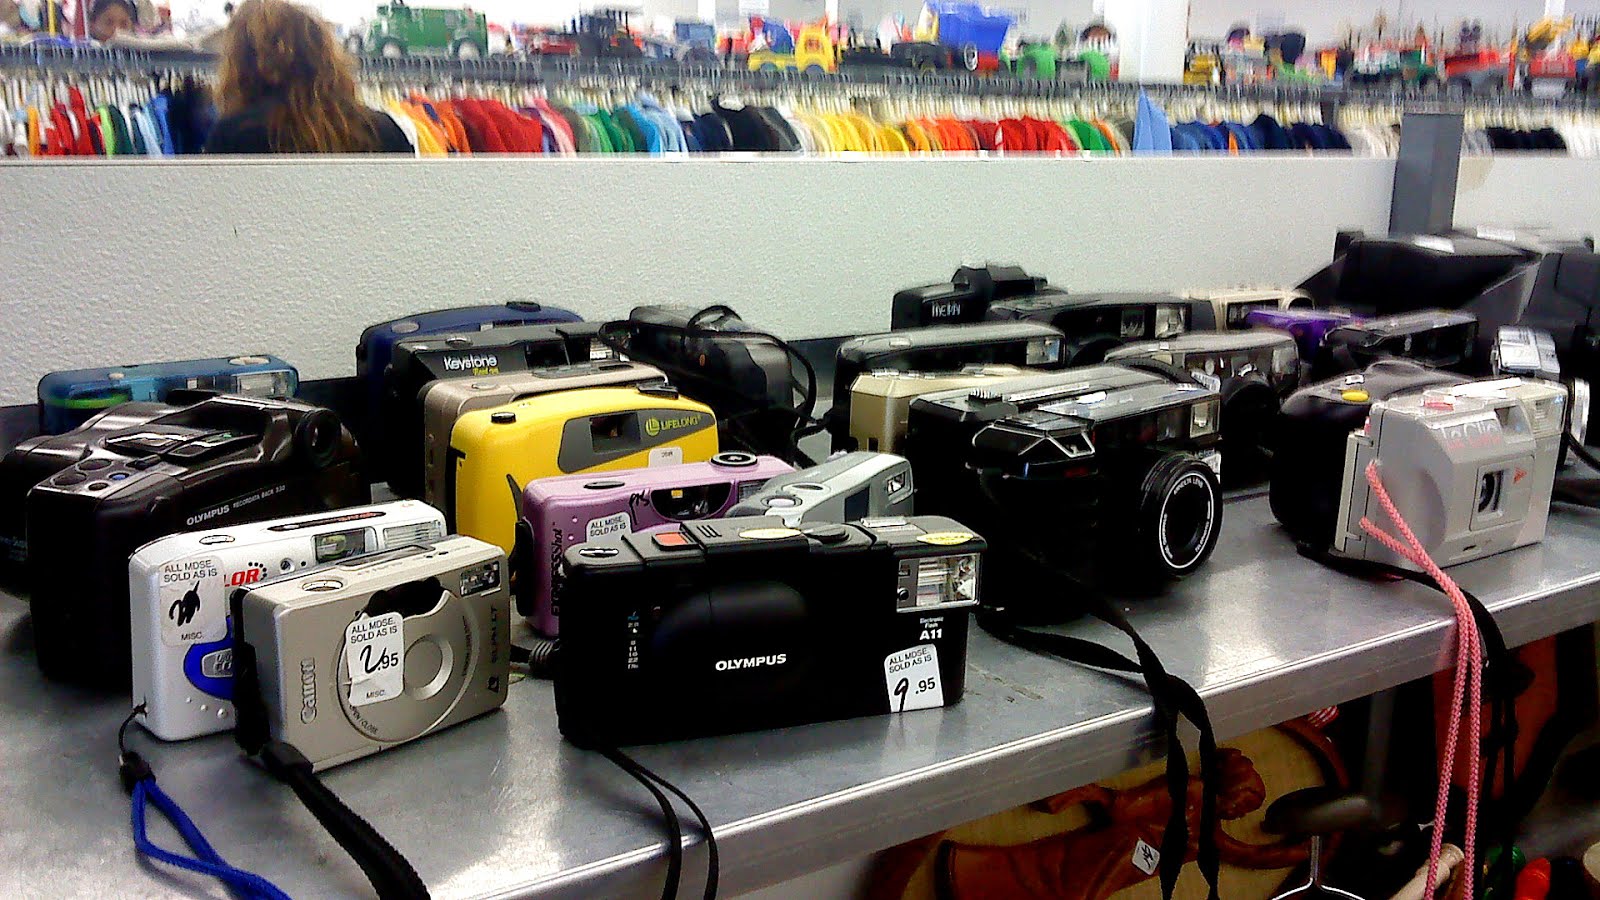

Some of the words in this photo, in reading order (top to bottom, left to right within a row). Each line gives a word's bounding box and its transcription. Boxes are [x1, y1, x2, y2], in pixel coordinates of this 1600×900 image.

[444, 354, 498, 371] Keystone
[186, 505, 230, 526] OLYMPUS
[590, 520, 604, 529] ALL
[590, 527, 609, 537] SOLD
[610, 525, 618, 533] AS
[619, 522, 627, 530] IS
[164, 565, 182, 574] ALL
[164, 573, 191, 583] SOLD
[193, 570, 206, 579] AS
[208, 568, 217, 577] IS
[351, 625, 368, 634] ALL
[351, 632, 374, 644] SOLD
[376, 628, 387, 637] AS
[389, 625, 398, 634] IS
[920, 628, 942, 640] A11
[715, 653, 787, 671] OLYMPUS
[889, 655, 903, 666] ALL
[889, 661, 911, 674] SOLD
[912, 657, 922, 666] AS
[924, 654, 932, 662] IS
[301, 657, 317, 724] Canon
